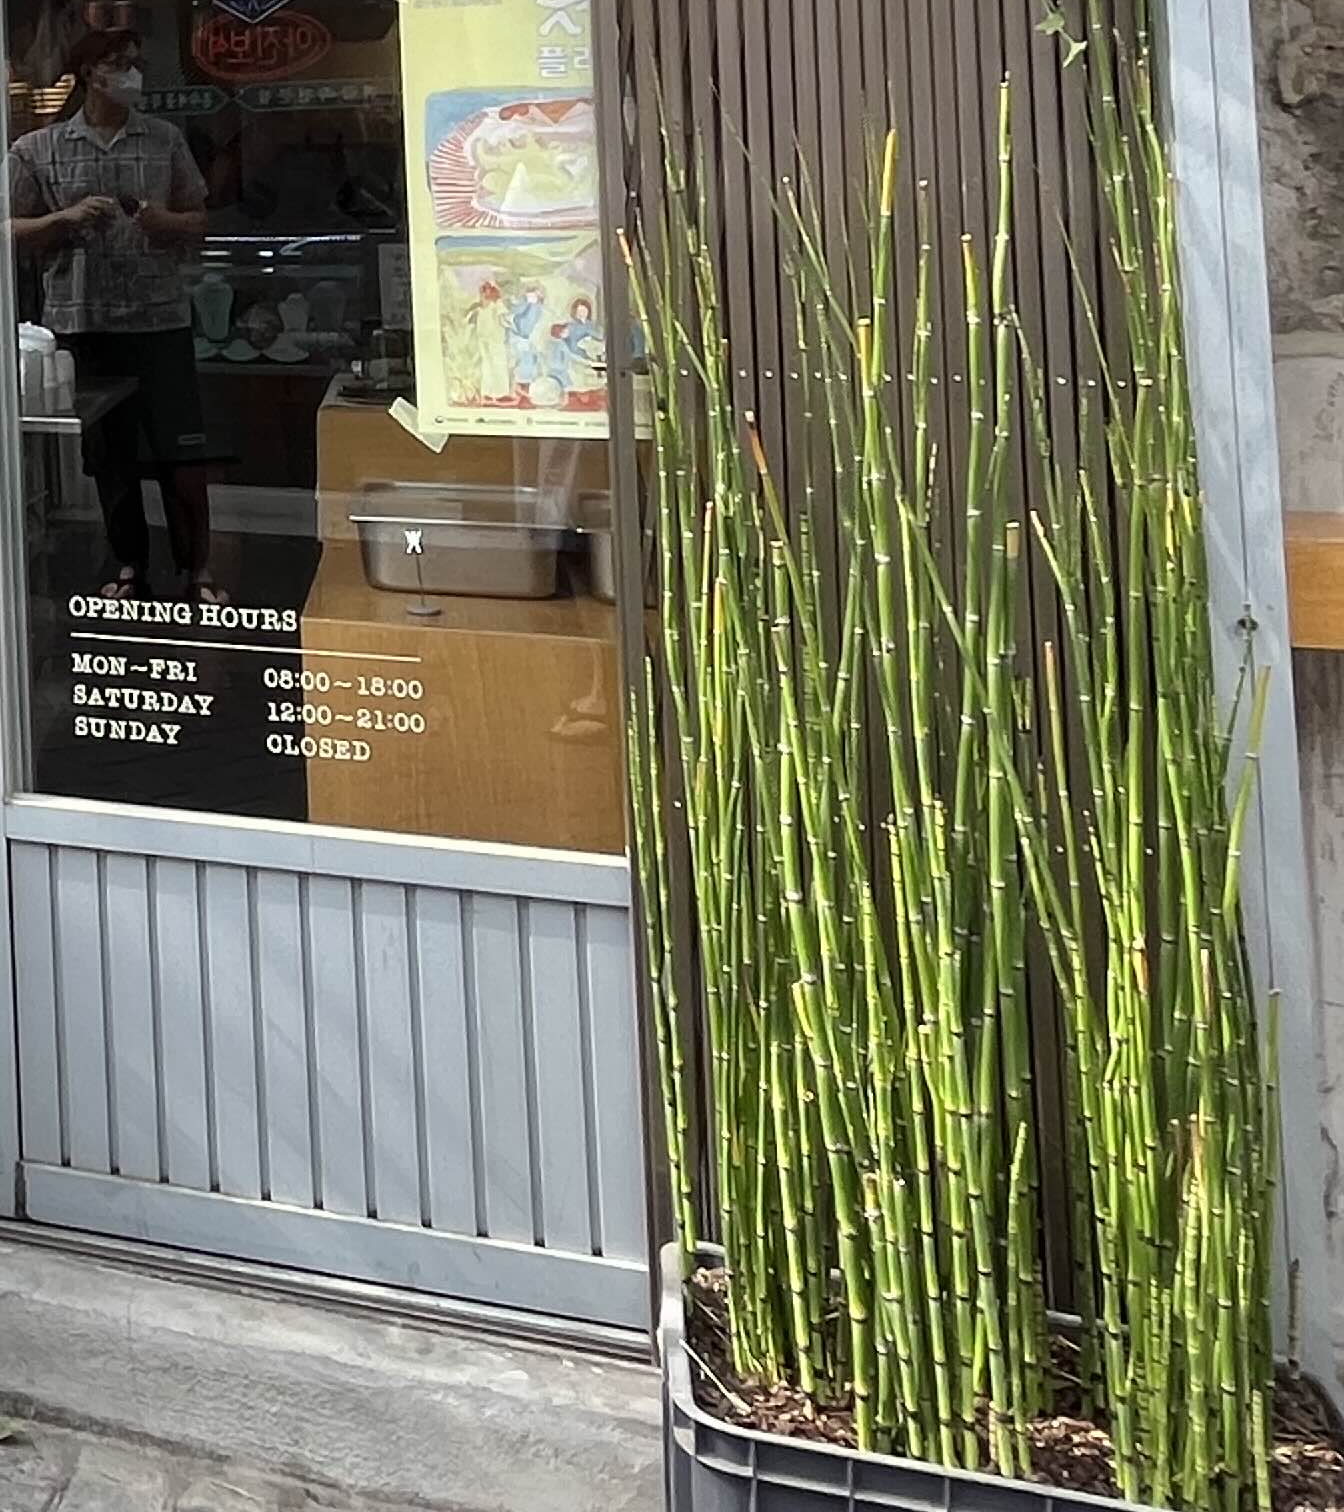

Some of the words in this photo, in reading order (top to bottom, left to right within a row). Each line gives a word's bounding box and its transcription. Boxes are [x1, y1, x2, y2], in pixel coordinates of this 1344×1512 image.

[69, 595, 192, 626] OPENING
[199, 603, 298, 633] HOURS
[73, 684, 214, 717] SATURDAY
[74, 716, 182, 745] SUNDAY
[265, 733, 372, 763] CLOSED
